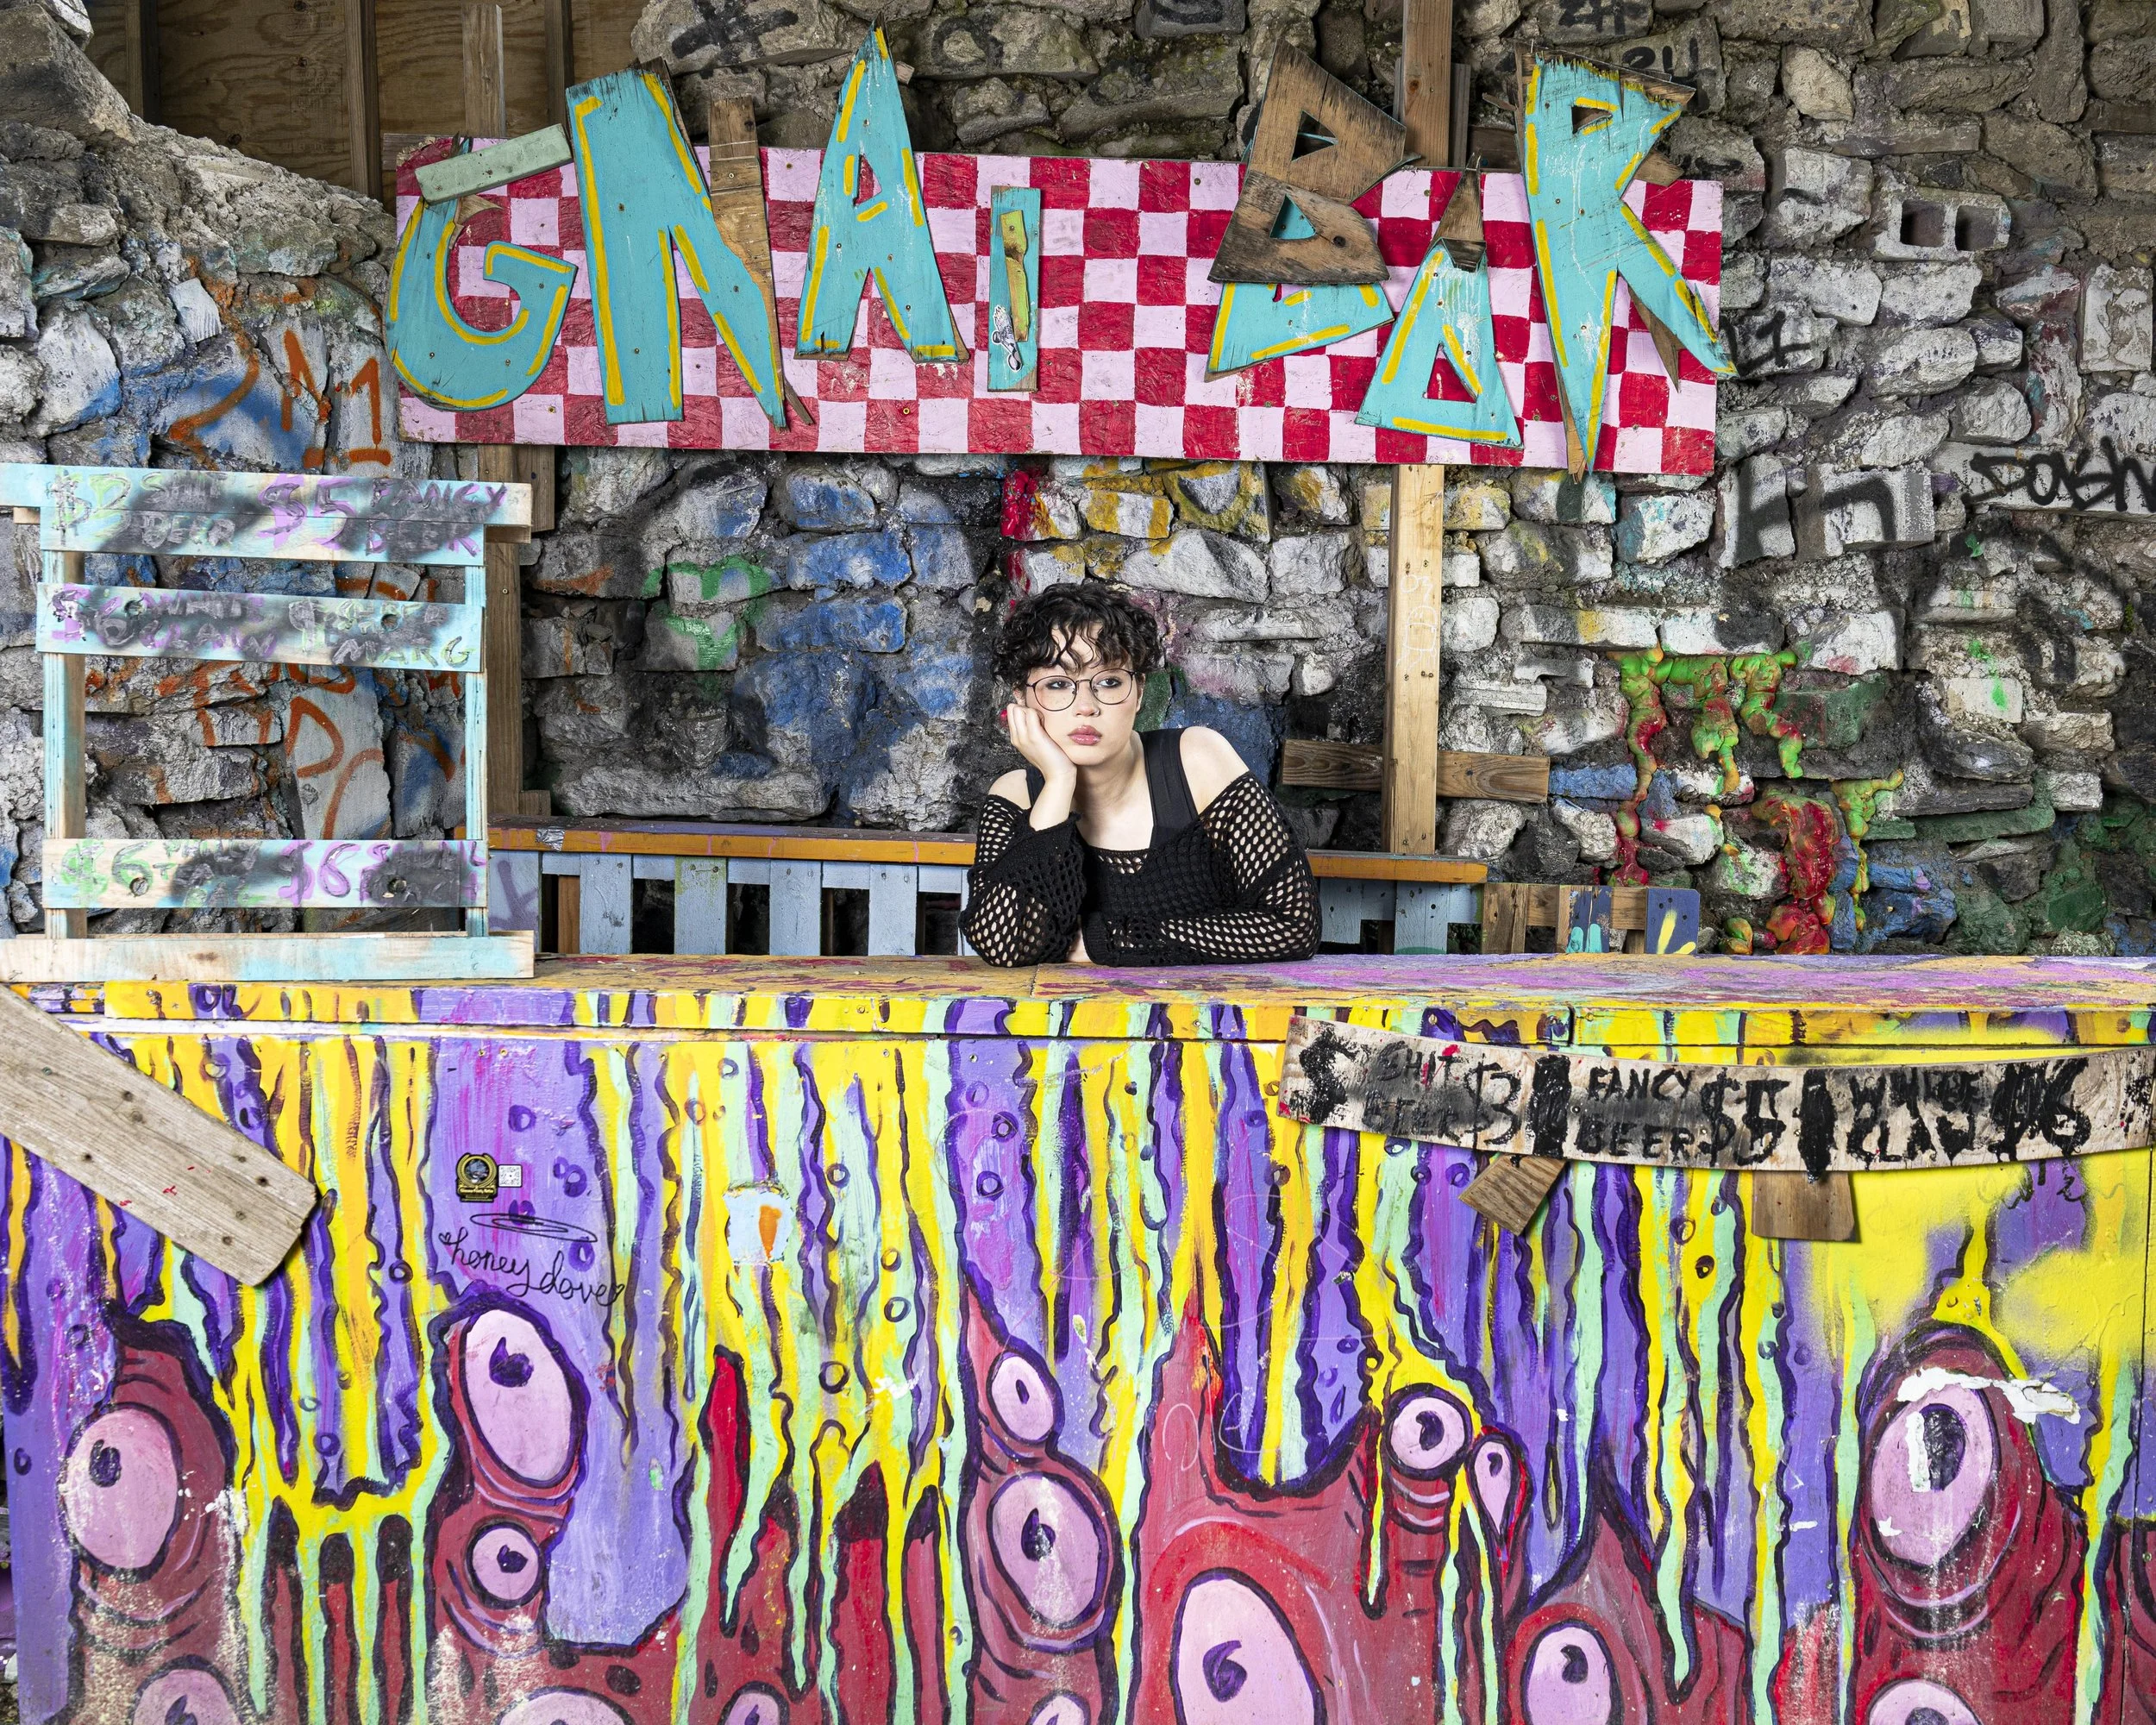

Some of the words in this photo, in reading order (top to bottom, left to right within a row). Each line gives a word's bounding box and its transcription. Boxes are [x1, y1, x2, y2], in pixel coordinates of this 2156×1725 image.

[1205, 40, 1739, 476] BAR
[1589, 1066, 1695, 1102] FANCY
[450, 1226, 531, 1297] honey
[538, 1250, 616, 1308] dove
